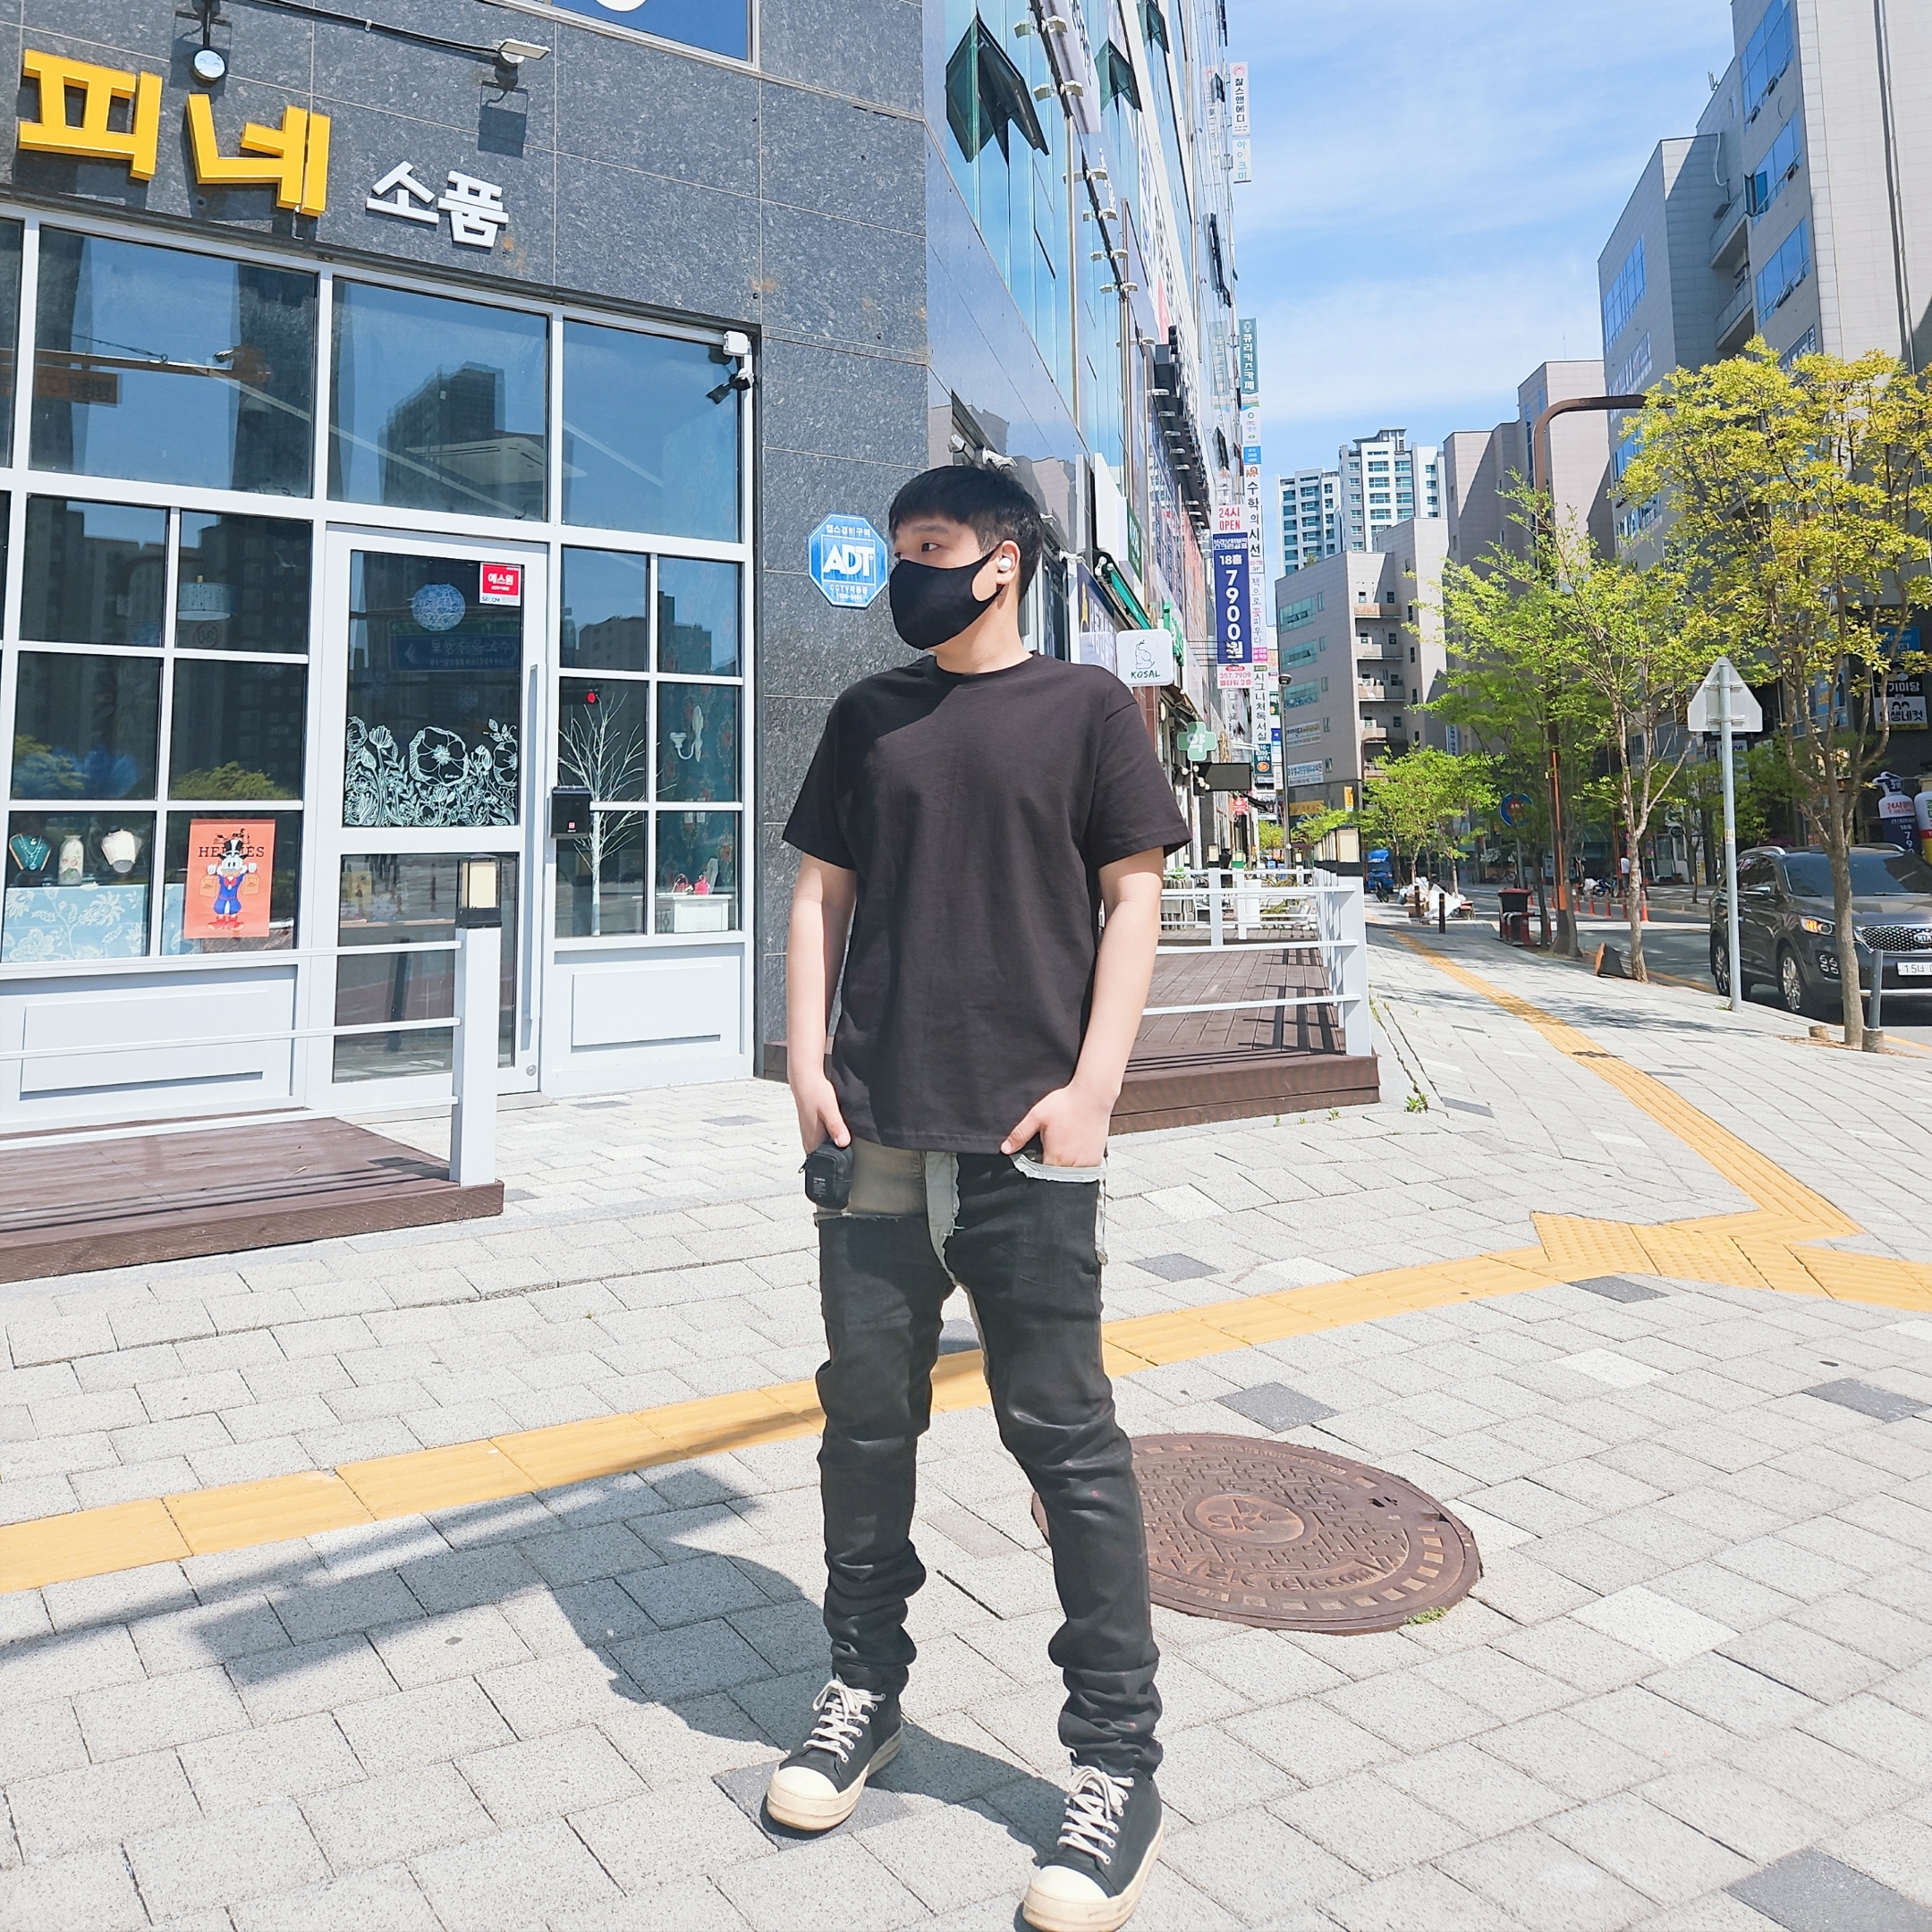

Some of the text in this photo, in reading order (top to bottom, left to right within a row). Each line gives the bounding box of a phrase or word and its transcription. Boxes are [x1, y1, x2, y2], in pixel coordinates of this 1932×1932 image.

[18, 48, 510, 249] 피네 소품
[1219, 507, 1241, 518] 24시
[1219, 520, 1241, 531] OPEN
[823, 544, 874, 577] ADT
[1219, 554, 1242, 565] 18홀
[487, 573, 514, 586] 에스원
[1131, 670, 1161, 679] KOSAL
[1186, 733, 1206, 753] 약
[1267, 1567, 1377, 1591] telecom
